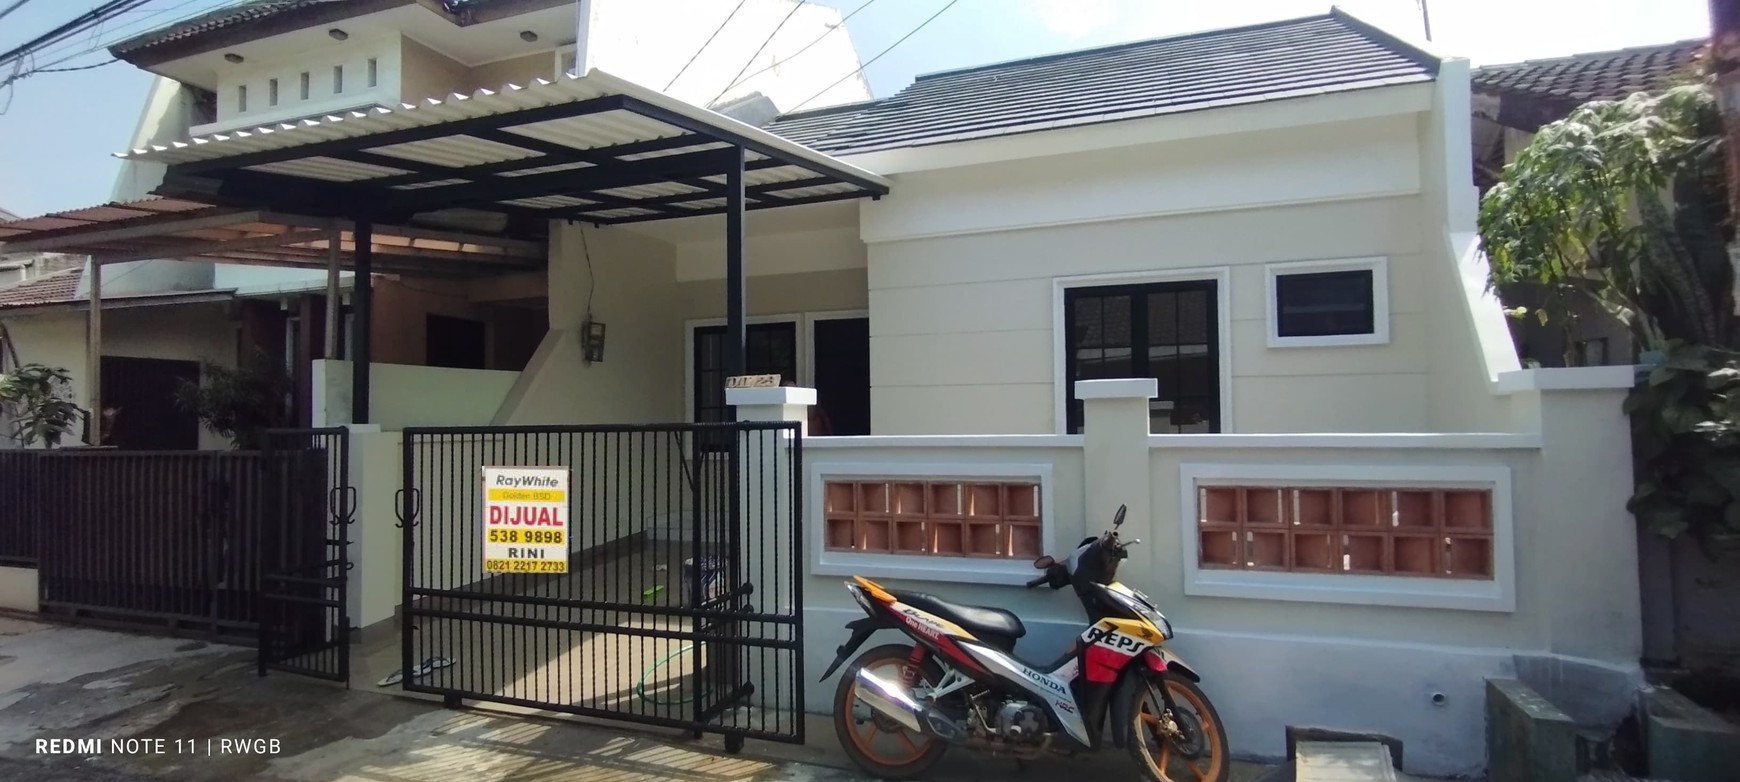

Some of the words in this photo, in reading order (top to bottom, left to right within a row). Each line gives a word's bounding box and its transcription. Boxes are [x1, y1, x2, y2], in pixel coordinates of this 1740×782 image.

[496, 475, 559, 487] RayWhite
[533, 492, 551, 500] BSD
[489, 505, 564, 526] DIJUAL
[490, 530, 518, 542] 538
[525, 531, 563, 543] 9898
[508, 548, 545, 558] RINI
[486, 560, 510, 570] 0821
[513, 561, 538, 571] 2217
[541, 562, 565, 572] 2733
[1022, 667, 1067, 695] HONDA
